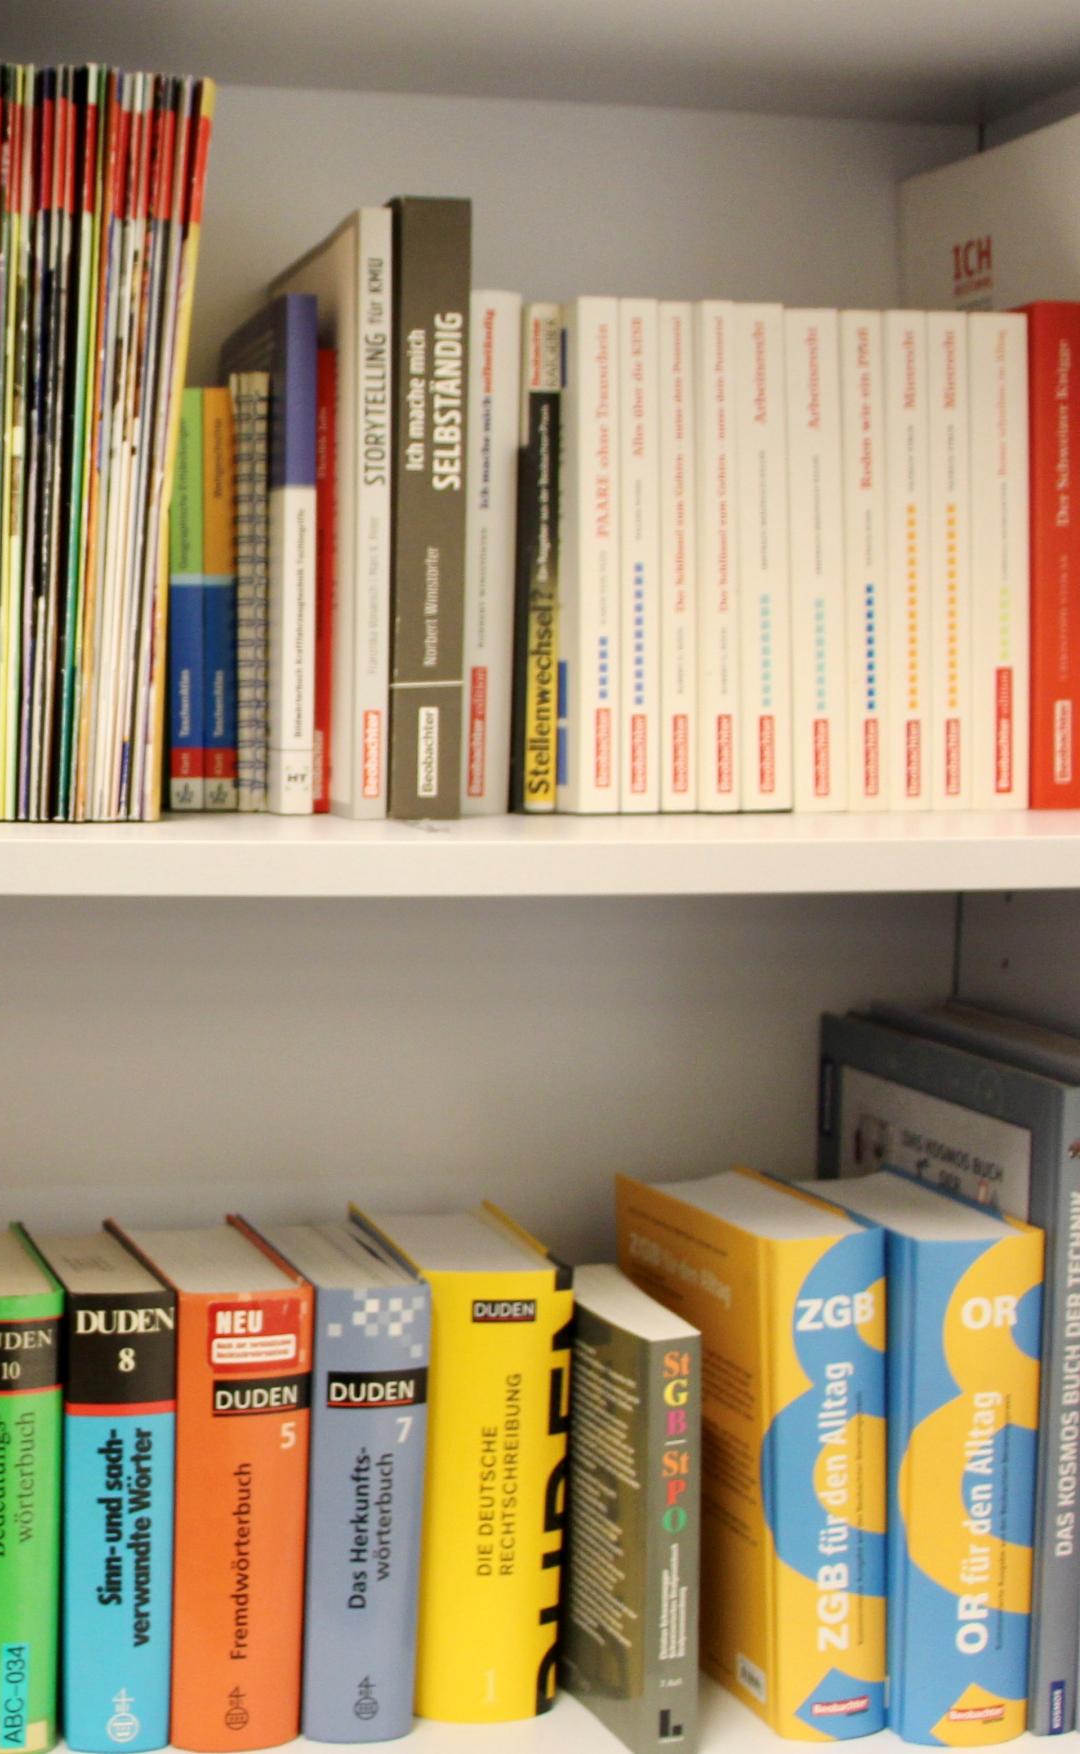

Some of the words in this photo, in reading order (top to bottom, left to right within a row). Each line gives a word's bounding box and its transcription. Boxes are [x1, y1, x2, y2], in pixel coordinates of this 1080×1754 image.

[370, 258, 384, 291] KMU
[952, 236, 992, 281] ICH
[367, 298, 384, 324] für
[407, 329, 426, 376] mich
[365, 333, 387, 487] STORYTELLING
[407, 378, 425, 441] mache
[430, 312, 463, 490] SELBSTÄNDIG
[406, 443, 424, 471] Ich
[1056, 405, 1069, 490] Schweizer
[1057, 496, 1069, 526] Der
[425, 547, 439, 615] Winistörfer
[424, 619, 439, 667] Norbert
[180, 669, 190, 737] TaschenAtlas
[529, 590, 554, 794] Stellenwechsel?
[366, 712, 379, 796] Beobachter
[421, 711, 435, 794] Beobachter
[76, 1306, 174, 1335] DUDEN
[216, 1310, 262, 1334] NEU
[474, 1303, 536, 1318] DUDEN
[797, 1293, 874, 1332] ZGB
[962, 1297, 1018, 1329] OR
[1065, 1297, 1080, 1340] DER
[1, 1362, 20, 1380] 10
[118, 1348, 135, 1372] 8
[1061, 1347, 1078, 1405] BUCH
[215, 1385, 298, 1411] DUDEN
[330, 1379, 414, 1402] DUDEN
[818, 1362, 854, 1447] Alltag
[280, 1422, 296, 1448] 5
[396, 1417, 412, 1444] 7
[966, 1392, 1003, 1475] Alltag
[15, 1410, 36, 1543] wörterbuch
[98, 1428, 123, 1491] sach-
[126, 1428, 152, 1517] Wörter
[479, 1426, 498, 1536] DEUTSCHE
[499, 1373, 522, 1576] RECHTSCHREIBUNG
[818, 1456, 847, 1504] den
[1059, 1411, 1077, 1508] KOSMOS
[98, 1497, 122, 1542] und
[349, 1447, 370, 1567] Herkunfts-
[376, 1452, 394, 1581] wörterbuch
[965, 1487, 993, 1536] den
[820, 1511, 849, 1555] für
[1055, 1512, 1073, 1557] DAS
[98, 1546, 121, 1606] Sinn-
[127, 1519, 152, 1647] verwandte
[230, 1463, 252, 1661] Fremdwörterbuch
[477, 1545, 493, 1577] DIE
[962, 1540, 990, 1590] für
[348, 1572, 367, 1610] Das
[818, 1564, 849, 1651] ZGB
[956, 1595, 989, 1654] OR
[3, 1646, 26, 1744] ABC-034
[1053, 1689, 1063, 1730] KOSMOS
